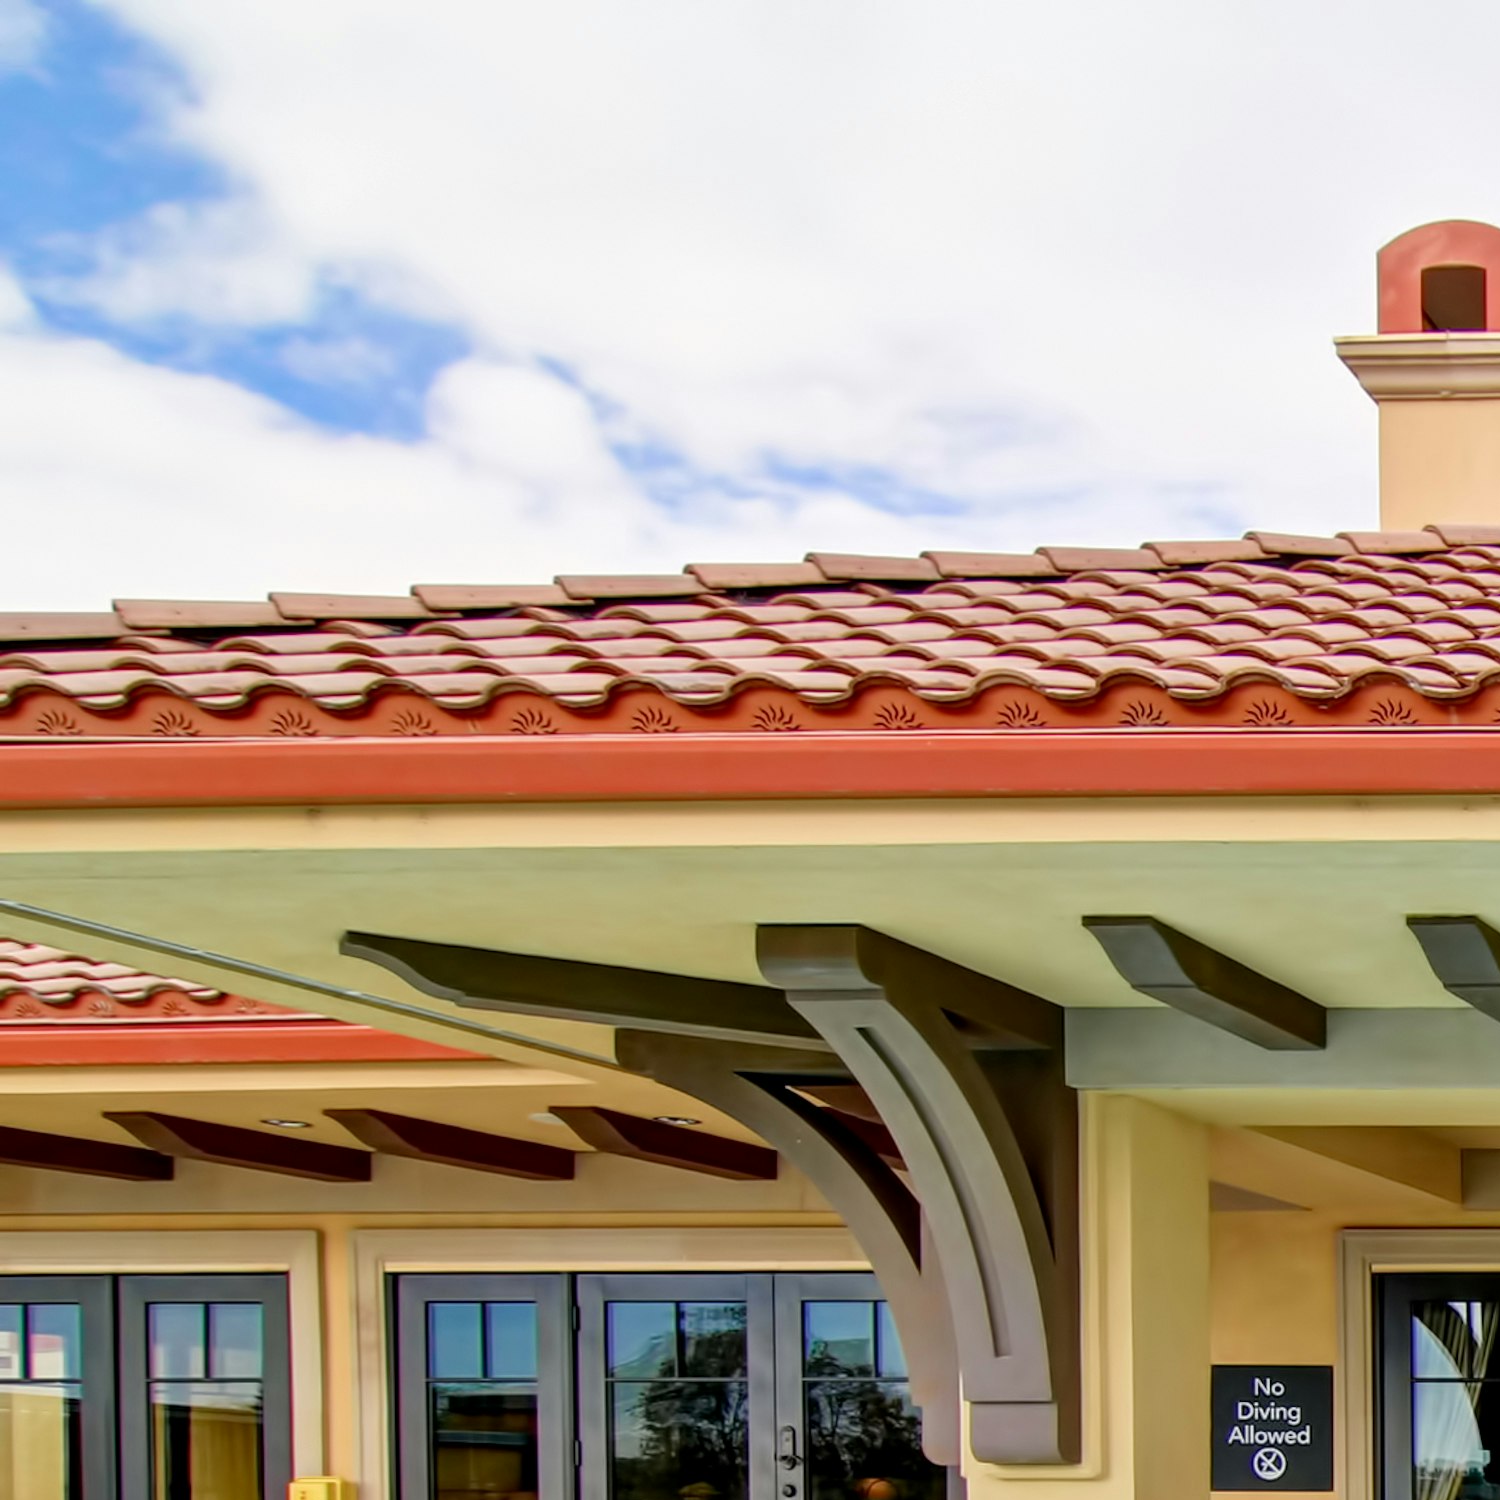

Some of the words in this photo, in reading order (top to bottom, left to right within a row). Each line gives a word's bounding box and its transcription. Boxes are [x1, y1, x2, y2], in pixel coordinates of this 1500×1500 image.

[1254, 1377, 1285, 1396] No
[1237, 1402, 1301, 1426] Diving
[1228, 1425, 1311, 1445] Allowed
